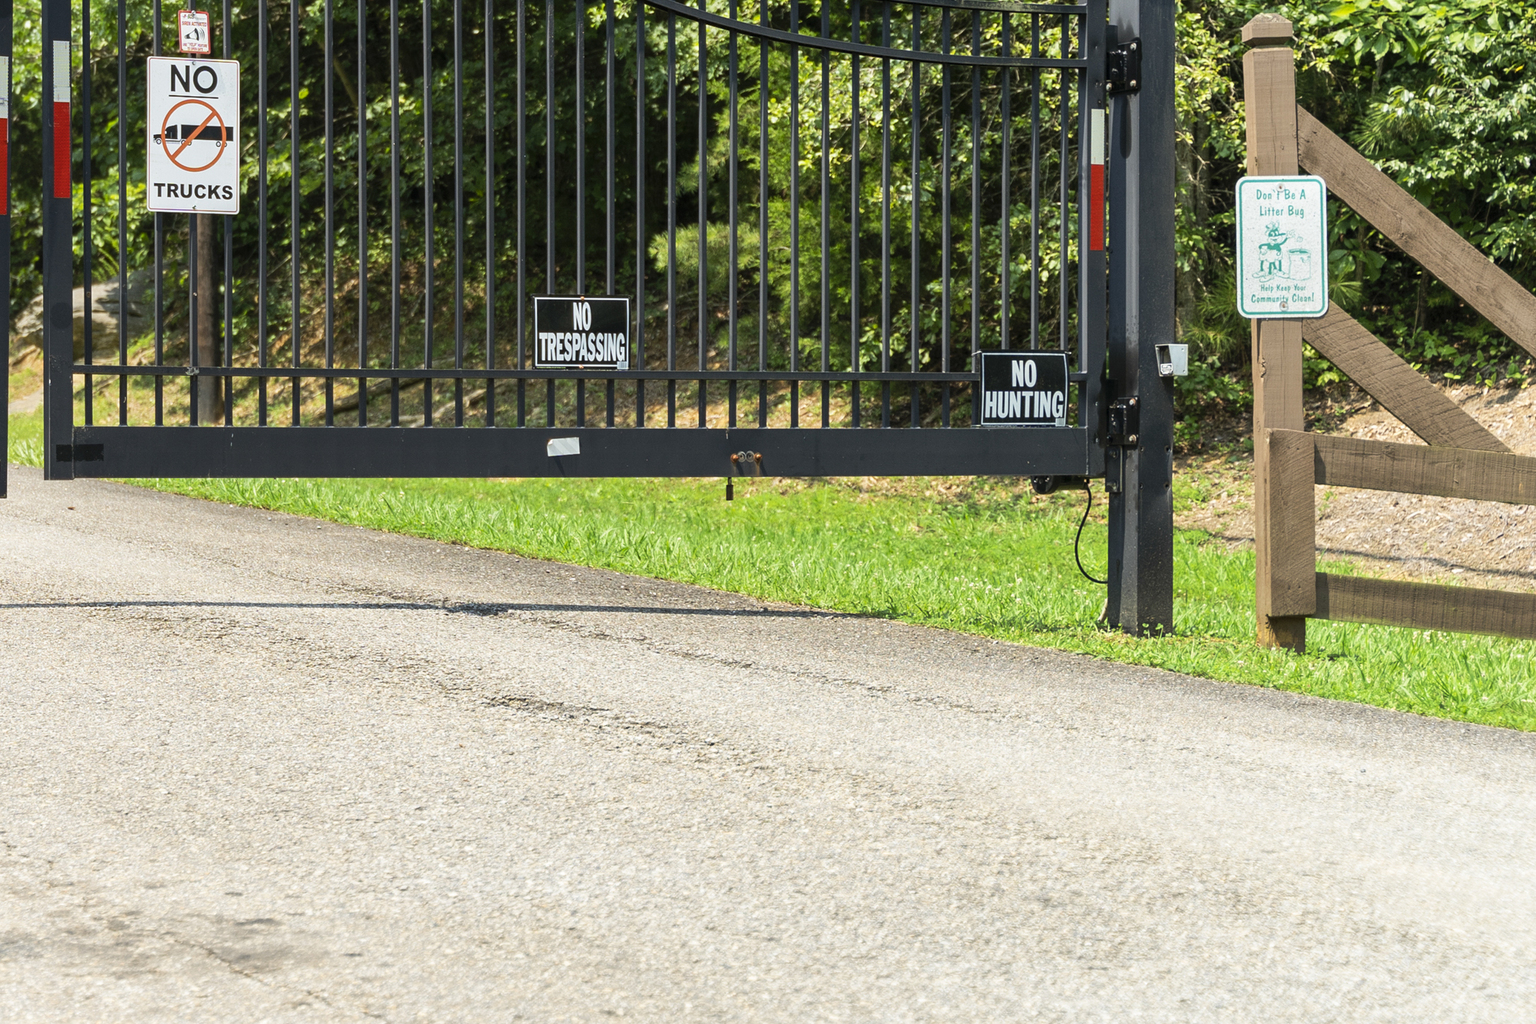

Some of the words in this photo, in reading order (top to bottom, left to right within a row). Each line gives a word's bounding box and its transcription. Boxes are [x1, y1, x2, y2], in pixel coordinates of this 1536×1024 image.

[170, 64, 218, 94] NO
[154, 182, 234, 200] TRUCKS
[1284, 188, 1296, 200] Be
[1300, 188, 1306, 200] A
[1260, 206, 1284, 216] Litter
[1288, 205, 1304, 219] Bug
[1251, 294, 1289, 303] Community
[1292, 292, 1314, 302] Clean!
[1260, 284, 1274, 293] Help
[1276, 284, 1291, 293] Keep
[1294, 283, 1306, 292] Your
[572, 302, 592, 331] NO
[538, 332, 626, 362] TRESPASSING
[1011, 360, 1038, 388] NO
[984, 390, 1064, 418] HUNTING
